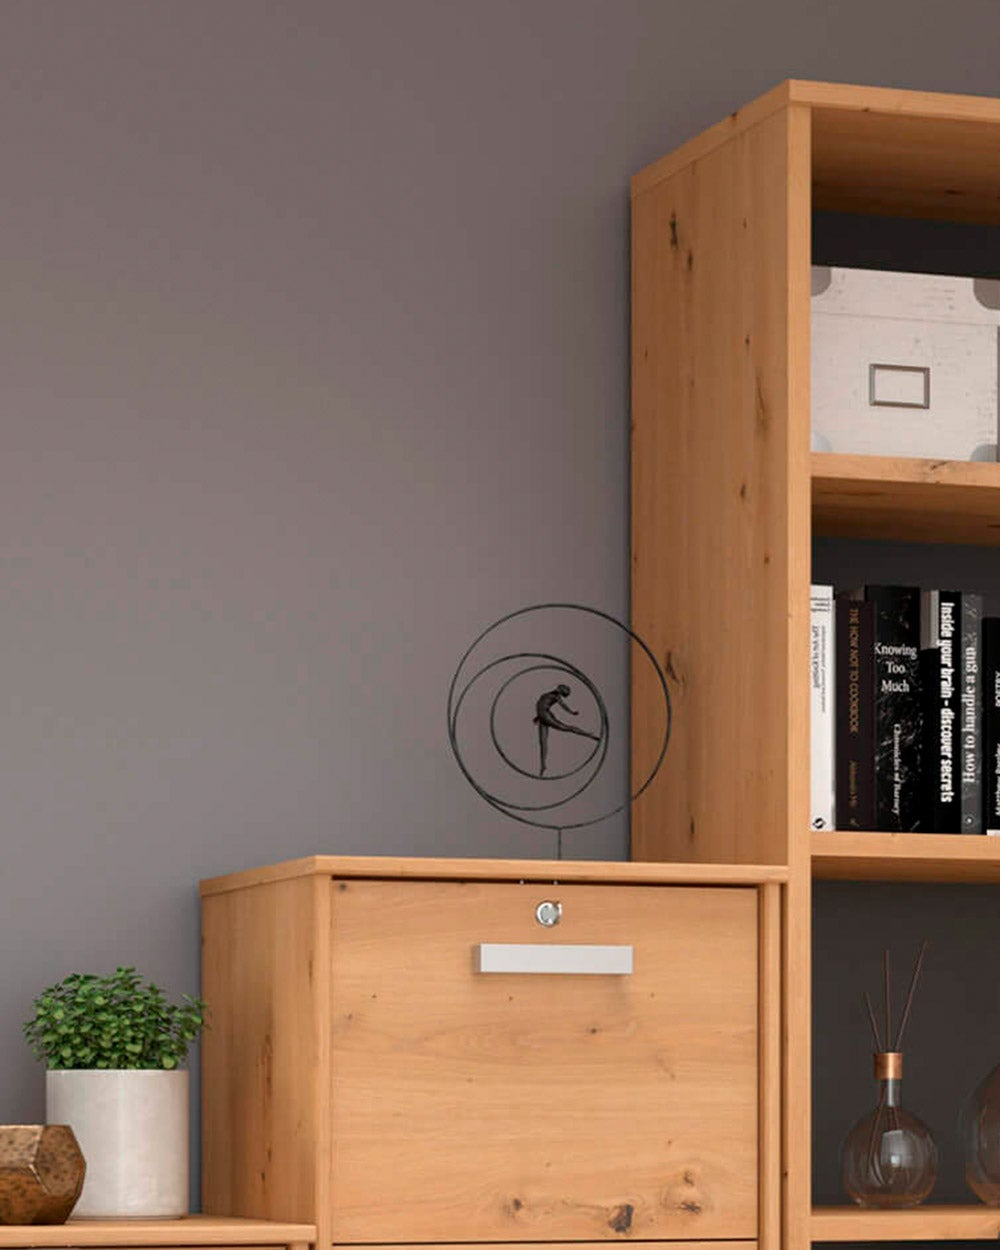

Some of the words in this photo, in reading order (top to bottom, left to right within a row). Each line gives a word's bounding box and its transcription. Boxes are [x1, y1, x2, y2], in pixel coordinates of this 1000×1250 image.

[941, 602, 955, 637] Inside
[850, 626, 860, 648] HOW
[850, 649, 860, 667] NOT
[874, 642, 917, 660] Knowing
[936, 639, 953, 667] your
[965, 647, 977, 673] gun
[886, 661, 905, 674] Too
[965, 675, 975, 684] a
[881, 680, 910, 693] Much
[941, 668, 955, 698] brain
[962, 686, 975, 732] handle
[941, 708, 955, 759] discover
[963, 736, 974, 748] to
[963, 752, 975, 783] How
[941, 760, 955, 803] secrets
